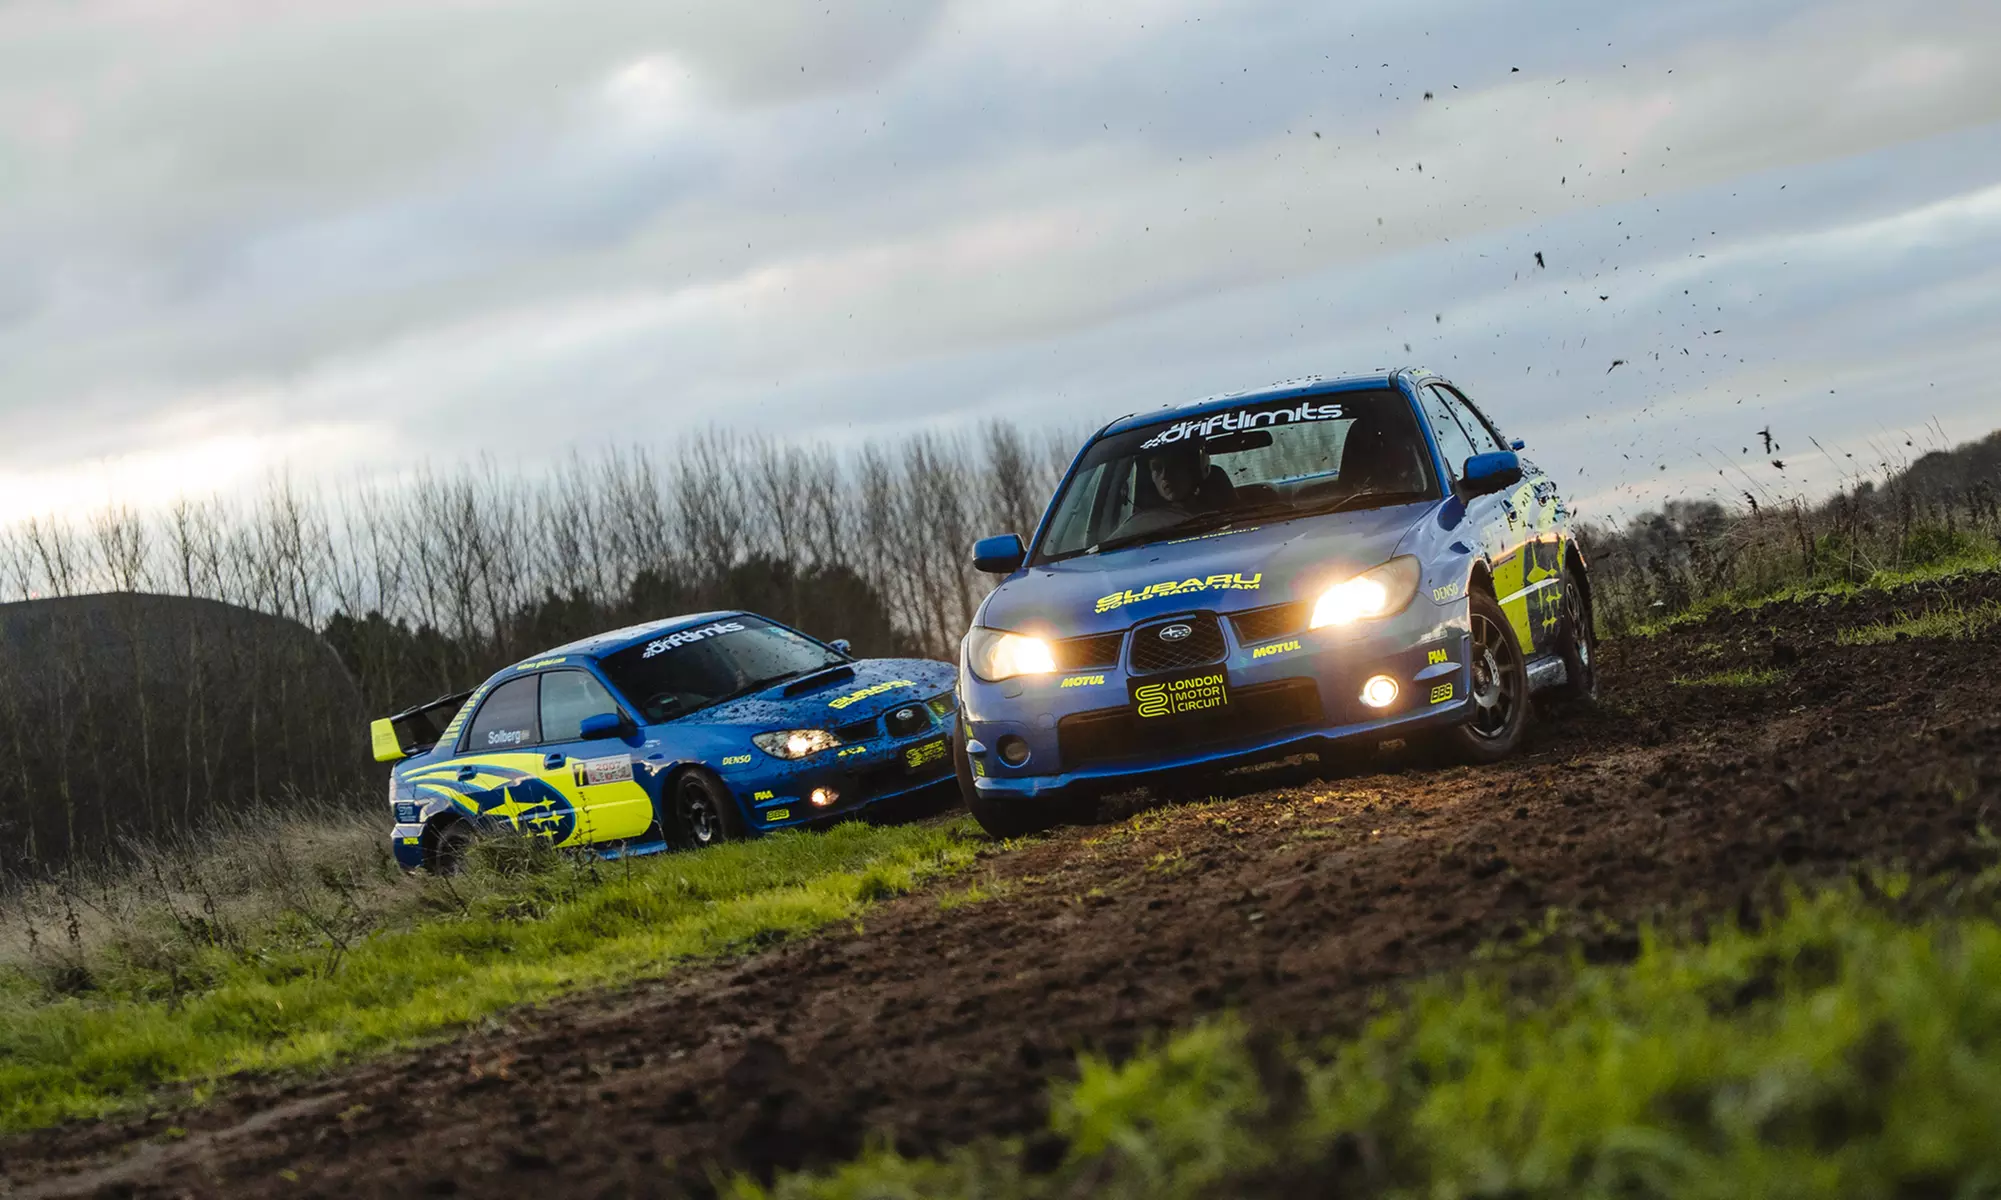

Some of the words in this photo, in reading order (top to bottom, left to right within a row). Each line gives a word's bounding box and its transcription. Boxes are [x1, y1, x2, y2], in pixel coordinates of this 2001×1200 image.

[1094, 594, 1153, 614] WORLD
[1158, 584, 1209, 598] RALLY
[1212, 582, 1260, 591] TEAM
[1096, 572, 1262, 608] SUBARU
[1432, 582, 1459, 602] DENSO
[1252, 640, 1302, 659] MOTUL
[1060, 674, 1105, 688] MOTUL
[1167, 673, 1224, 692] LONDON
[1174, 686, 1220, 702] MOTOR
[1177, 697, 1221, 713] CIRCUIT
[487, 729, 522, 745] Solberg
[722, 754, 752, 766] DENSO
[574, 763, 585, 786] 7
